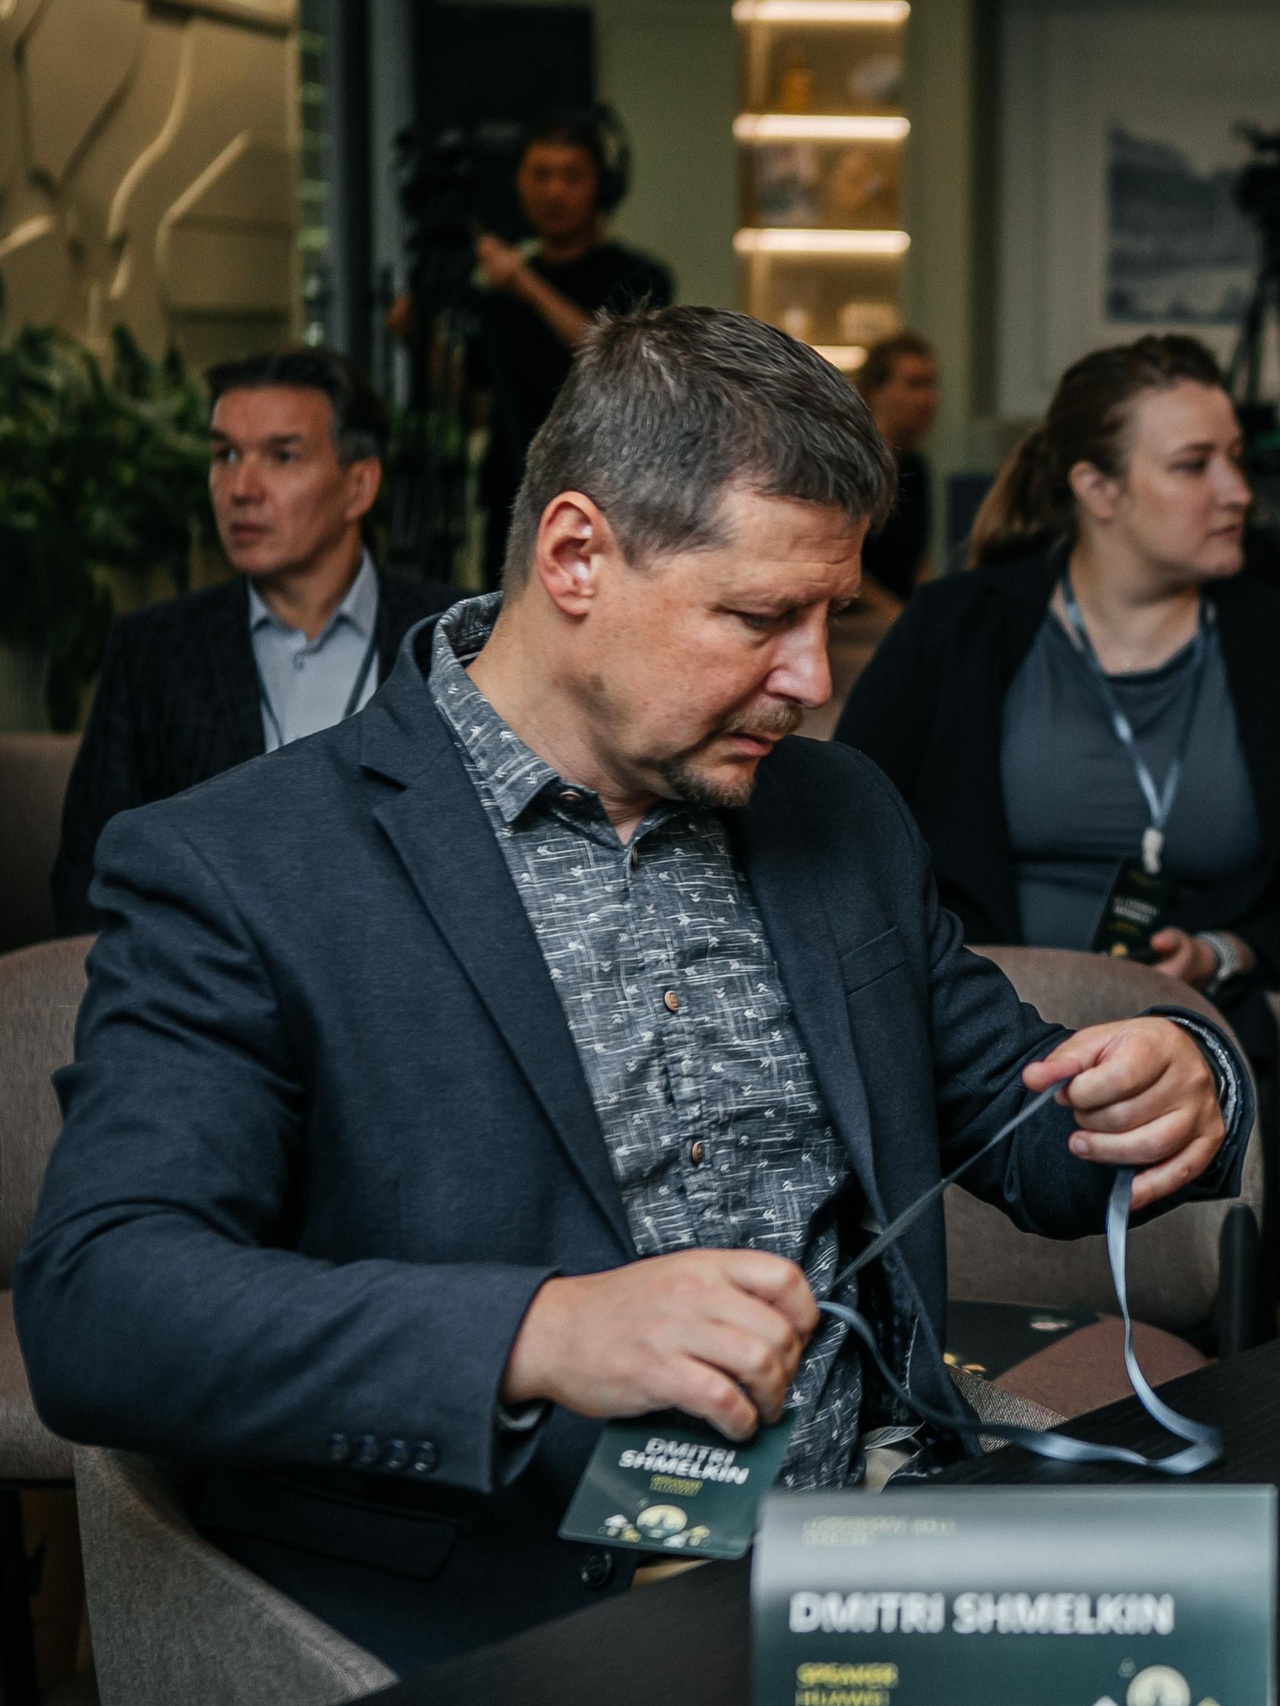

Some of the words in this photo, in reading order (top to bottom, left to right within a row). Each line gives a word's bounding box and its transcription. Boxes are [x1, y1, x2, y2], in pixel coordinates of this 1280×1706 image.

[618, 1449, 749, 1485] SHMELKIN
[645, 1437, 737, 1466] DMITRI
[789, 1591, 945, 1634] DMITRI
[952, 1592, 1175, 1635] SHMELKIN
